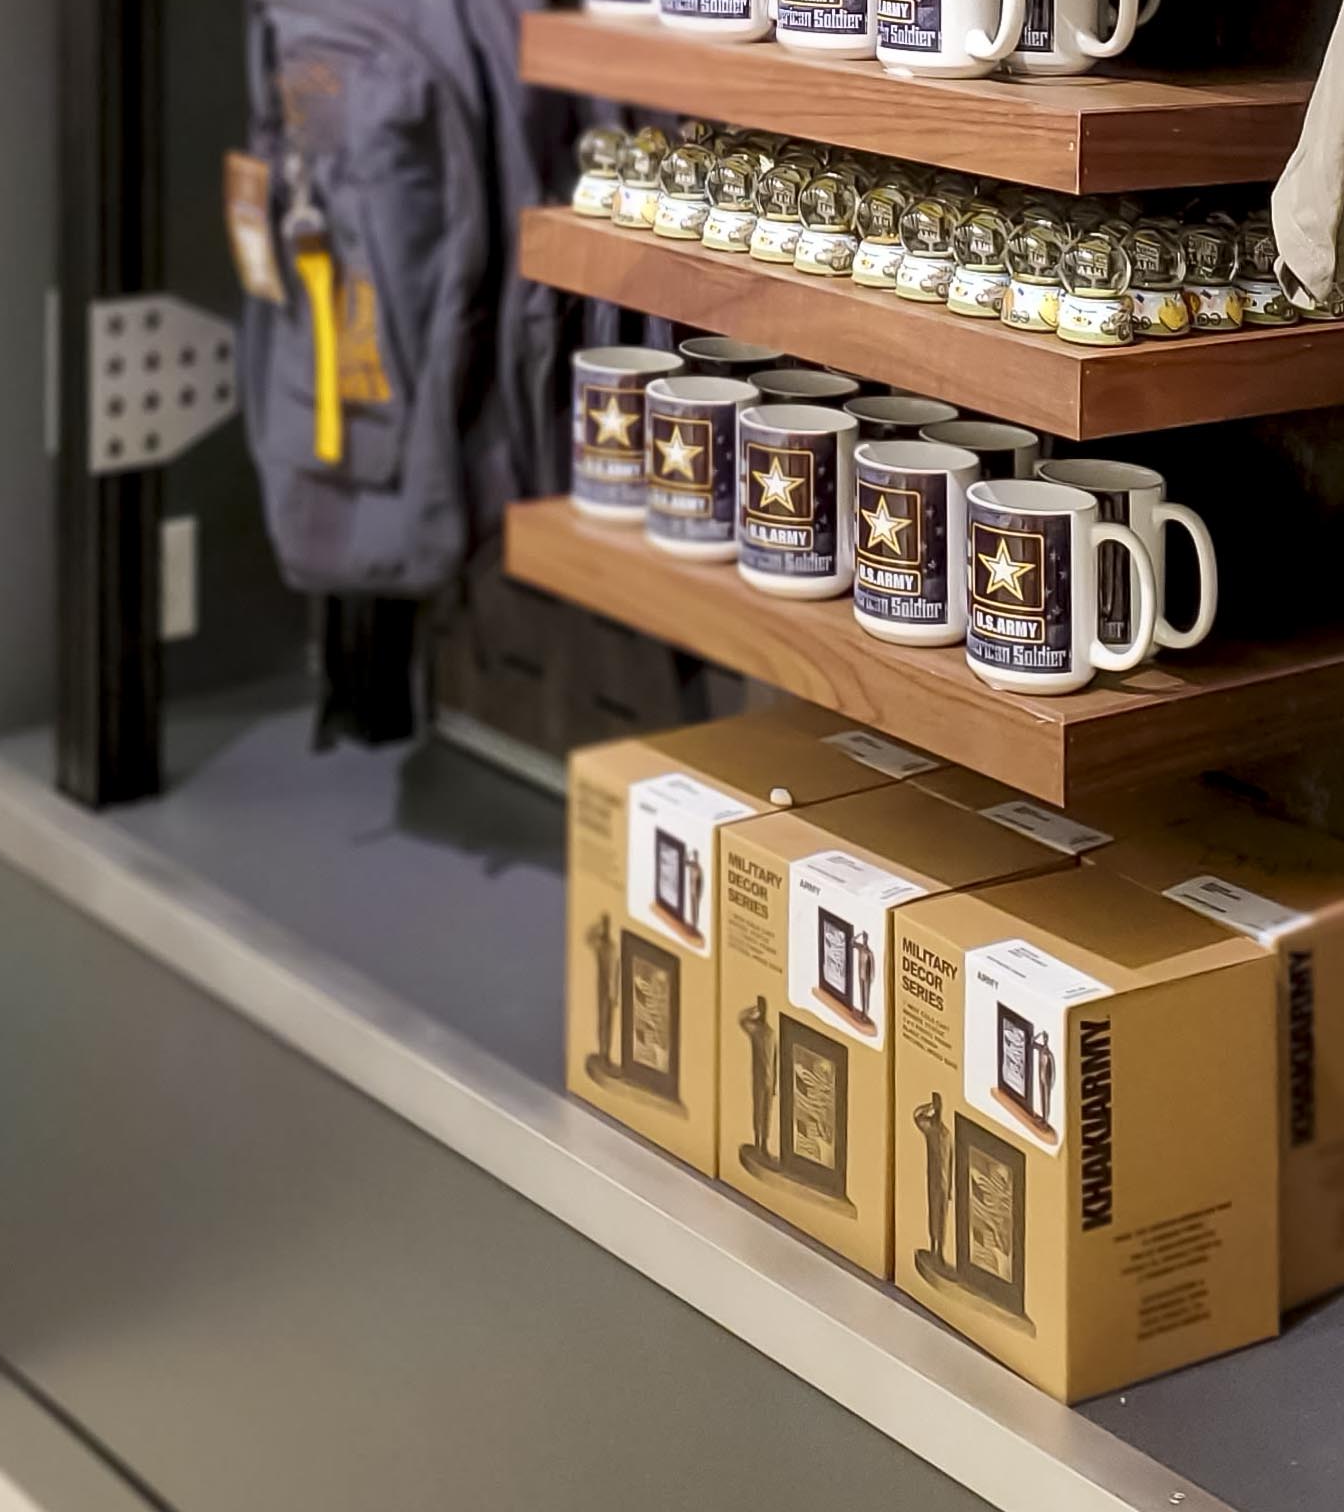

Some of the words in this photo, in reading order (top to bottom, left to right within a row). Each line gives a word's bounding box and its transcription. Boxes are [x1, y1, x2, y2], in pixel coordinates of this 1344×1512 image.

[813, 9, 862, 29] Soldier
[890, 25, 935, 47] Soldier
[859, 564, 914, 591] U.S.ARMY
[891, 596, 942, 619] Soldier
[976, 616, 1038, 639] U.S.ARMY
[1012, 645, 1066, 667] Soldier
[728, 852, 783, 889] MILITARY
[727, 870, 768, 901] DECOR
[727, 888, 769, 920] SERIES
[902, 937, 958, 980] MILITARY
[902, 956, 944, 992] DECOR
[902, 976, 944, 1011] SERIES
